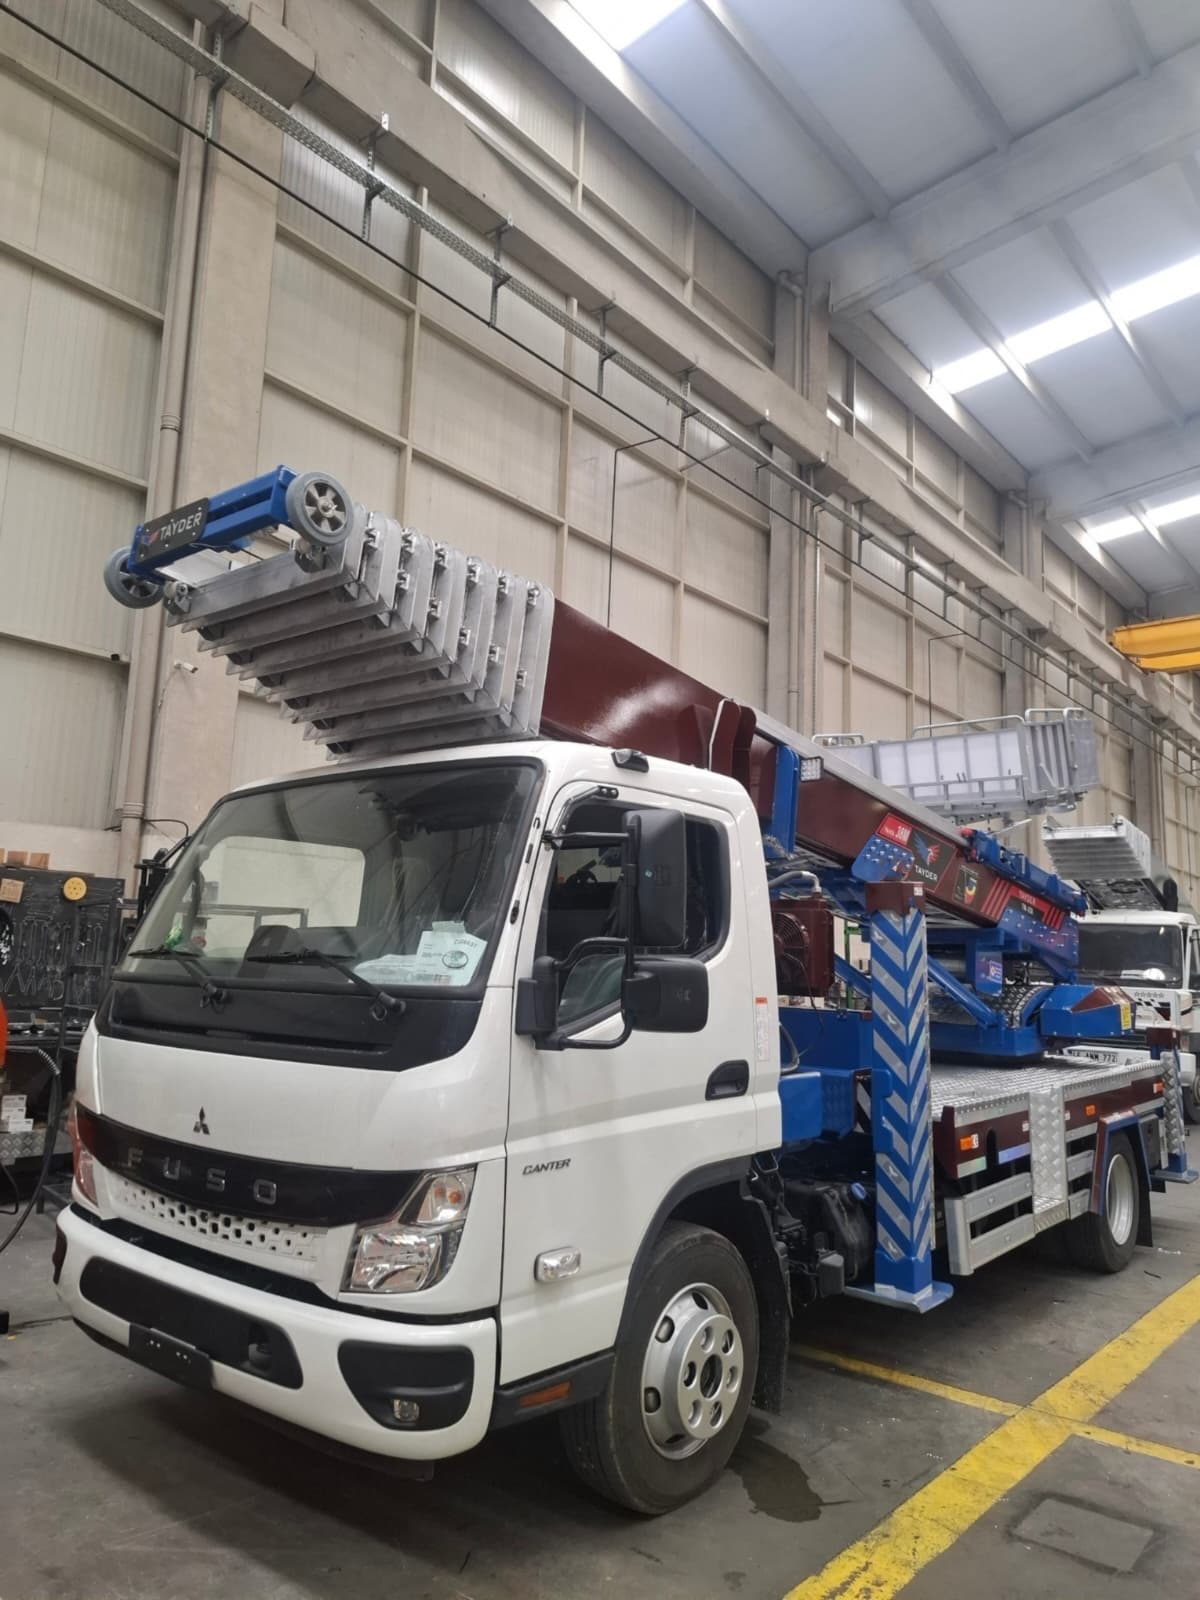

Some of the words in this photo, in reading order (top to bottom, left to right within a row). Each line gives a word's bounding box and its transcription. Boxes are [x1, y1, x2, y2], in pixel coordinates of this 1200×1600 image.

[160, 511, 203, 539] TAYDER
[914, 864, 938, 881] TAYDER
[127, 1147, 277, 1205] FUSO
[522, 1158, 572, 1176] CANTER
